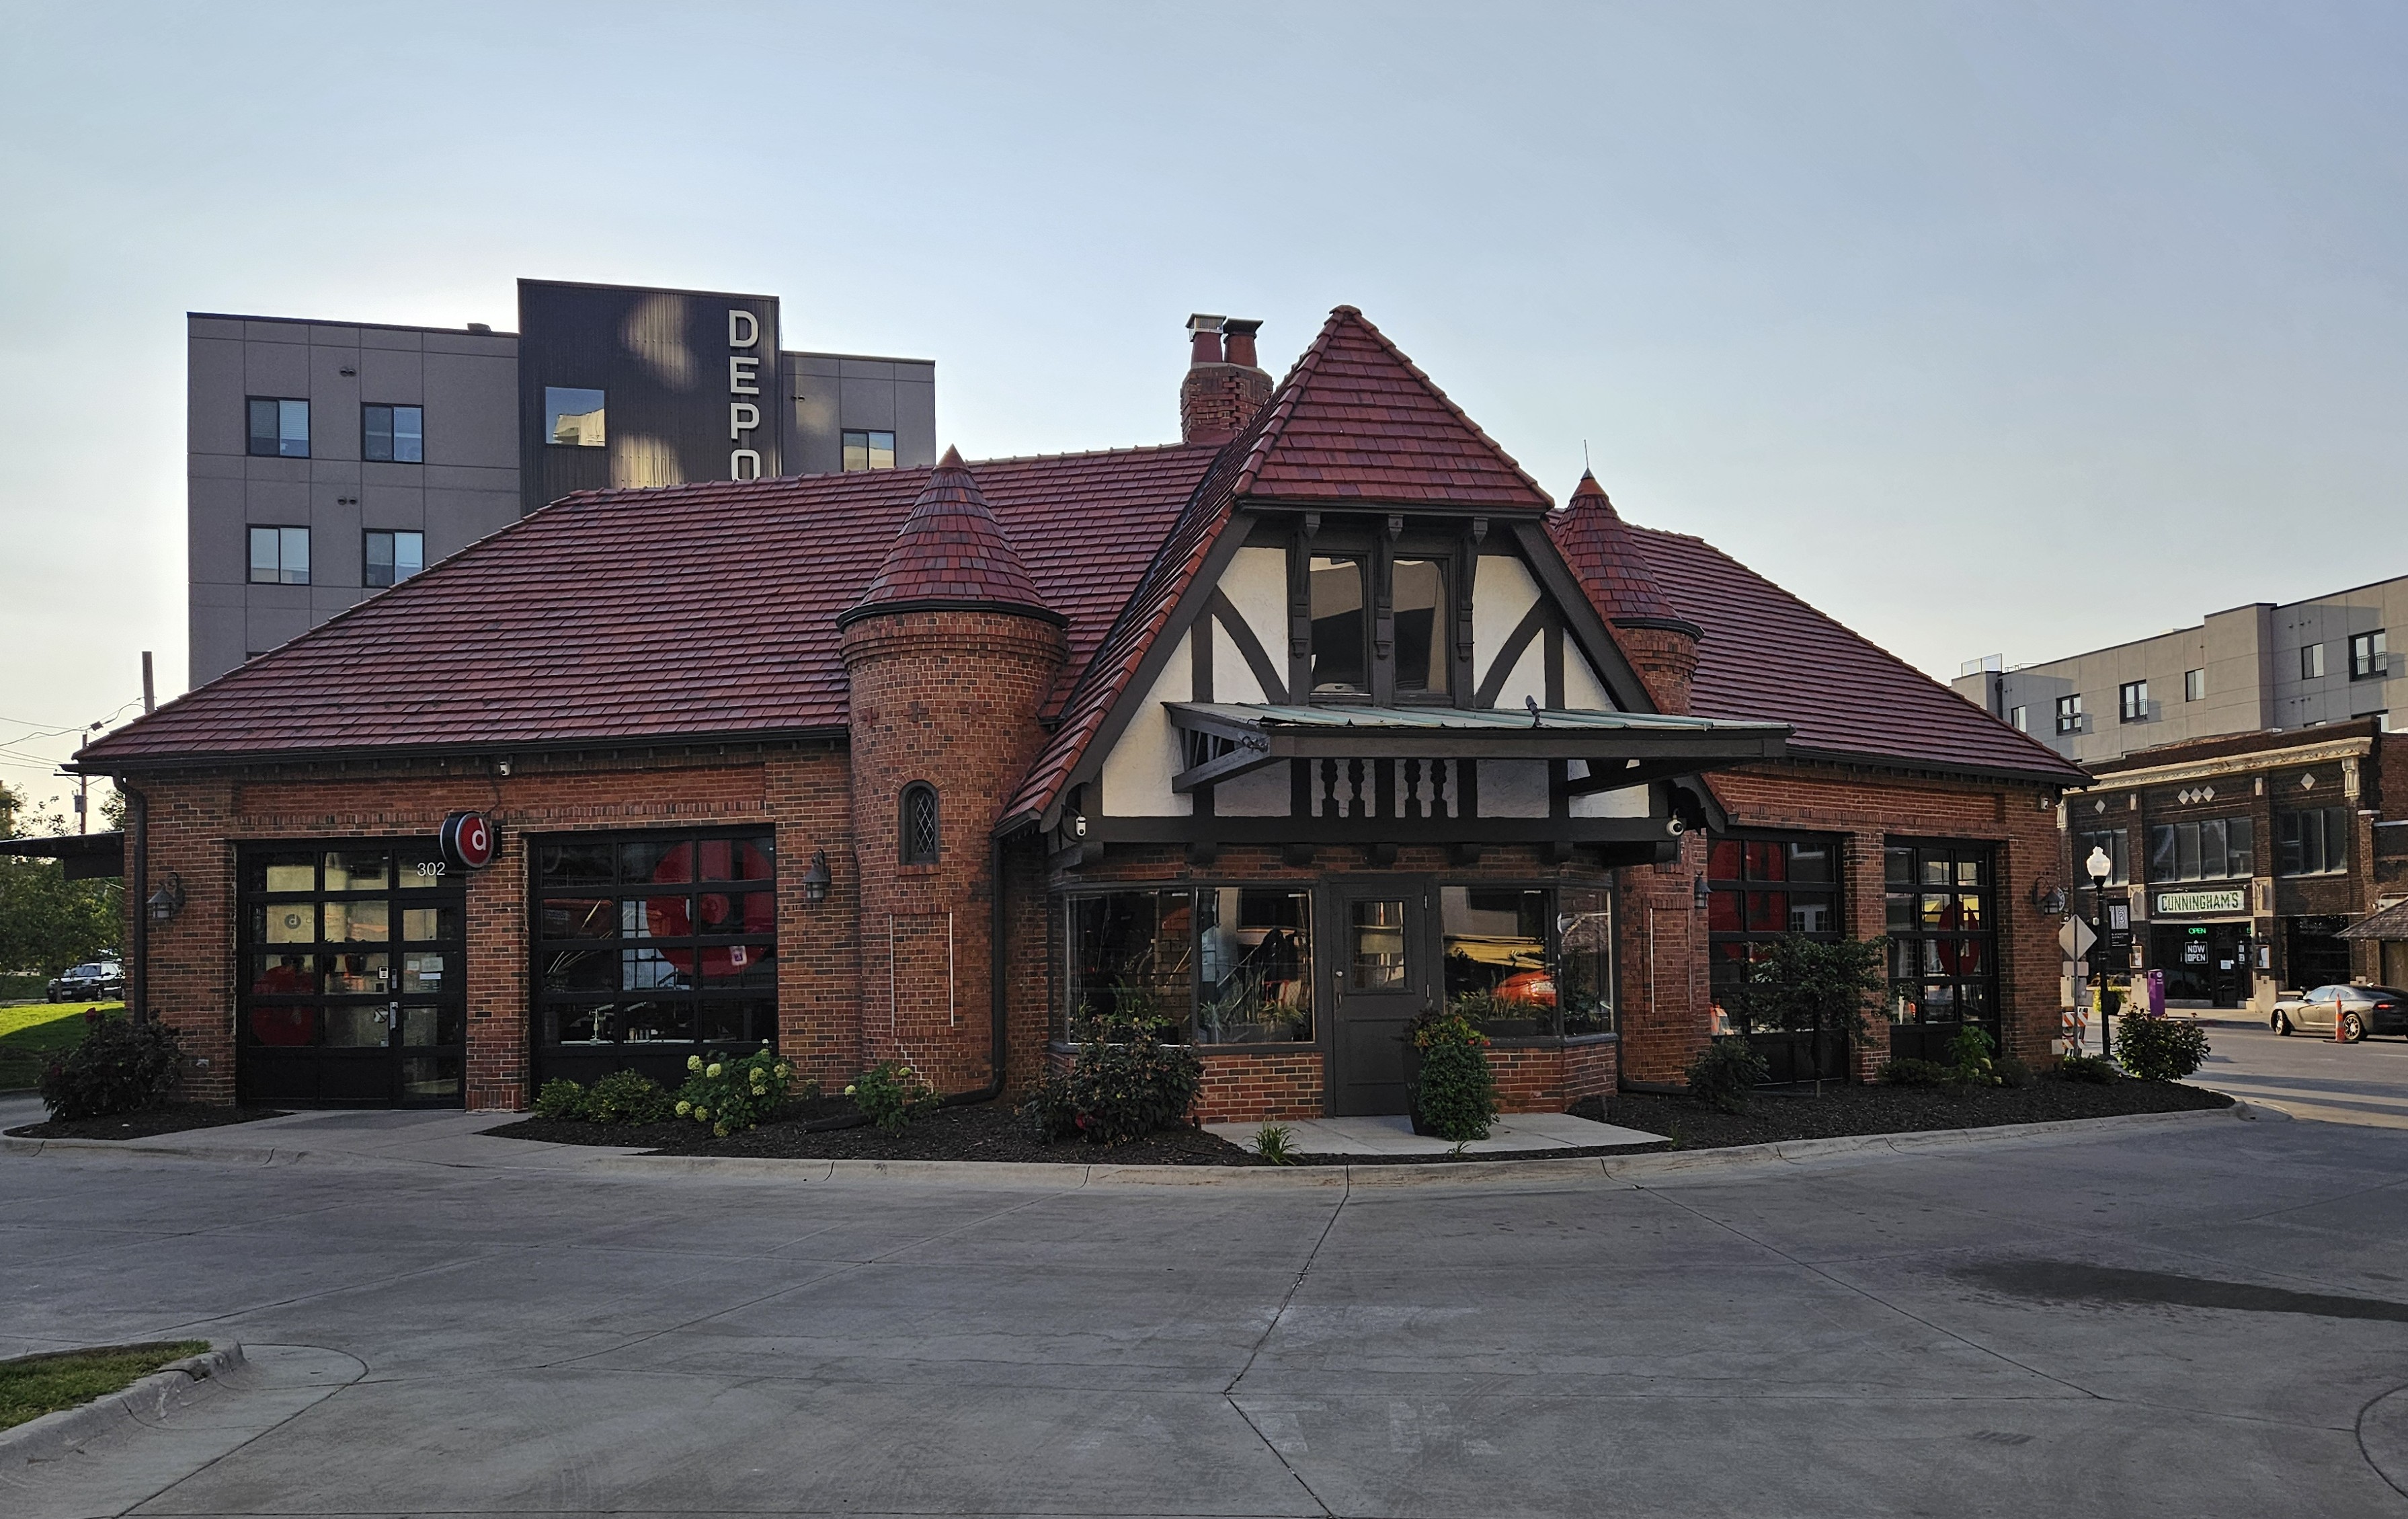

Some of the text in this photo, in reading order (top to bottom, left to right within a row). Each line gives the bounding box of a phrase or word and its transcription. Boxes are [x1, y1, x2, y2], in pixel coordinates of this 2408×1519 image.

[472, 818, 486, 851] d
[417, 861, 446, 877] 302
[2161, 892, 2239, 911] CUNNINGHAM'S
[2188, 945, 2205, 953] NOW
[2188, 953, 2206, 962] OPEN
